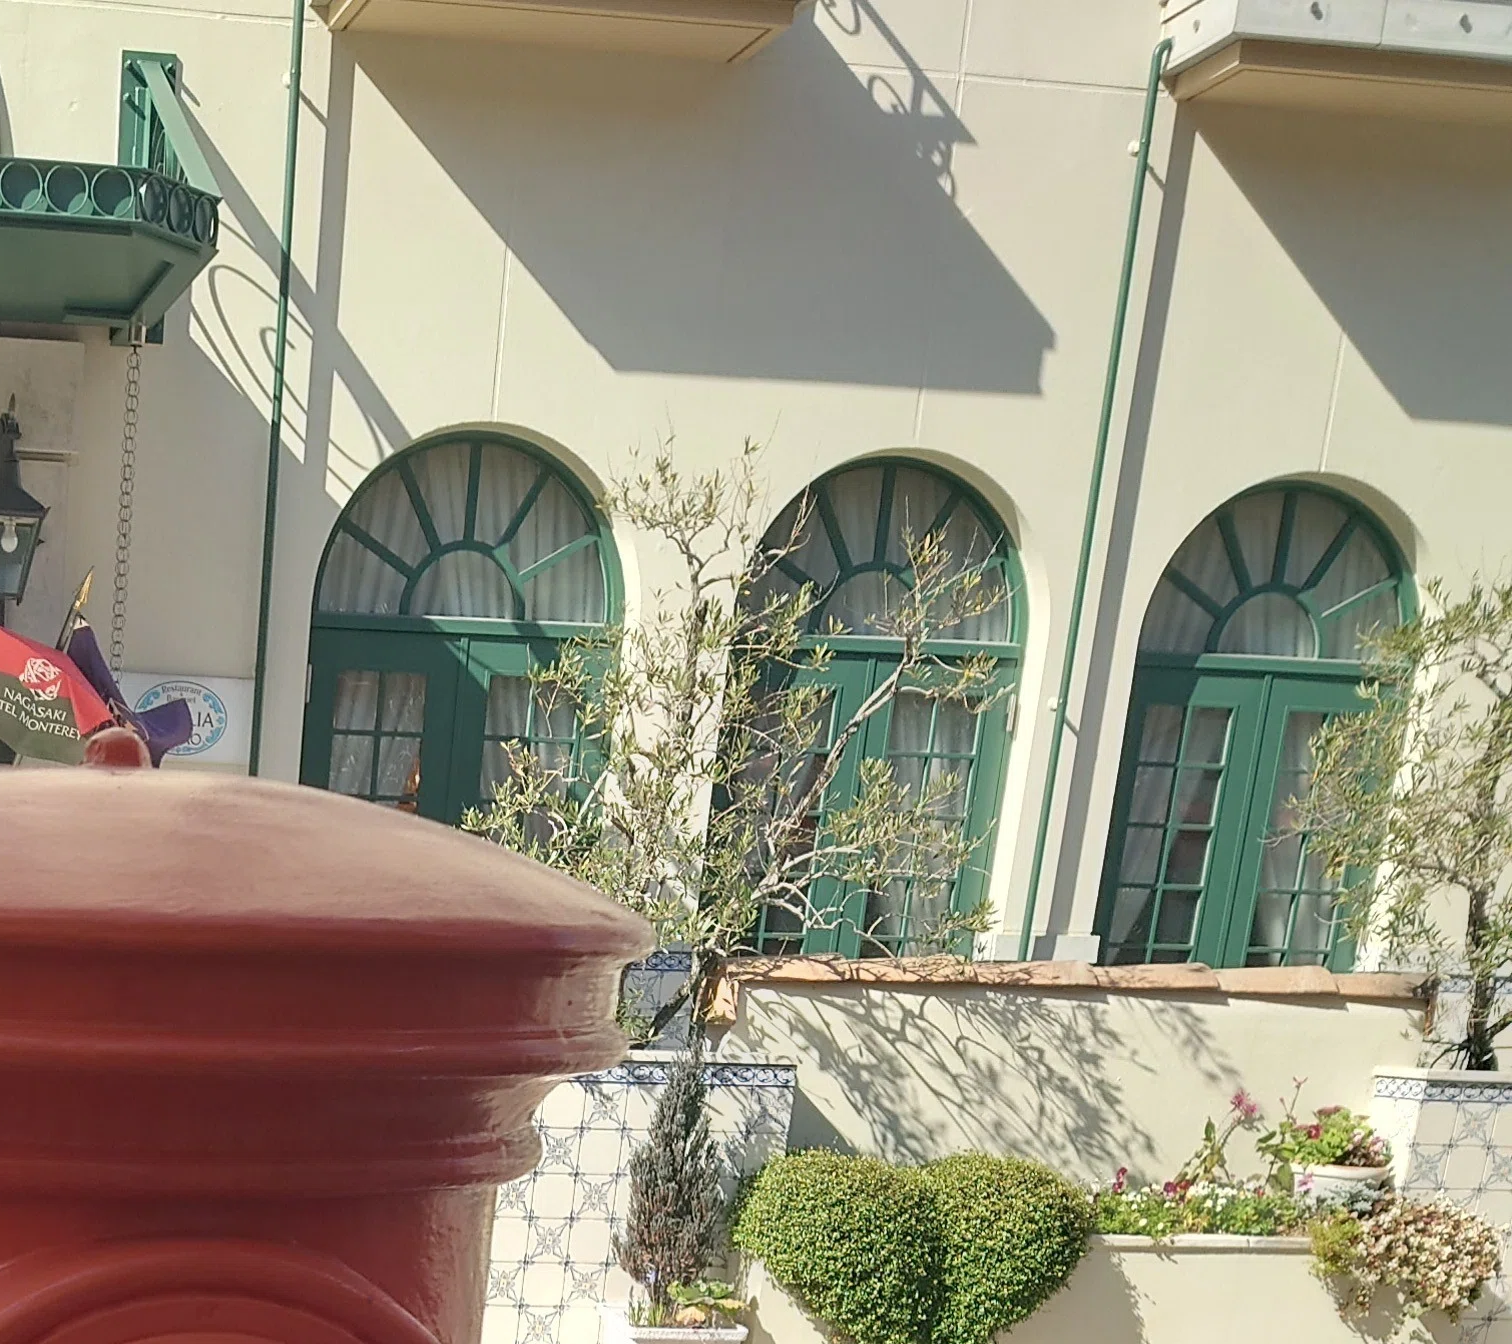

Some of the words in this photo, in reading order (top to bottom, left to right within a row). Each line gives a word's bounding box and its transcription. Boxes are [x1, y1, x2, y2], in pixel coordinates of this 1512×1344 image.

[4, 687, 66, 721] NAGASAKI
[161, 685, 202, 696] Restaurant
[19, 710, 81, 741] MONTEREY
